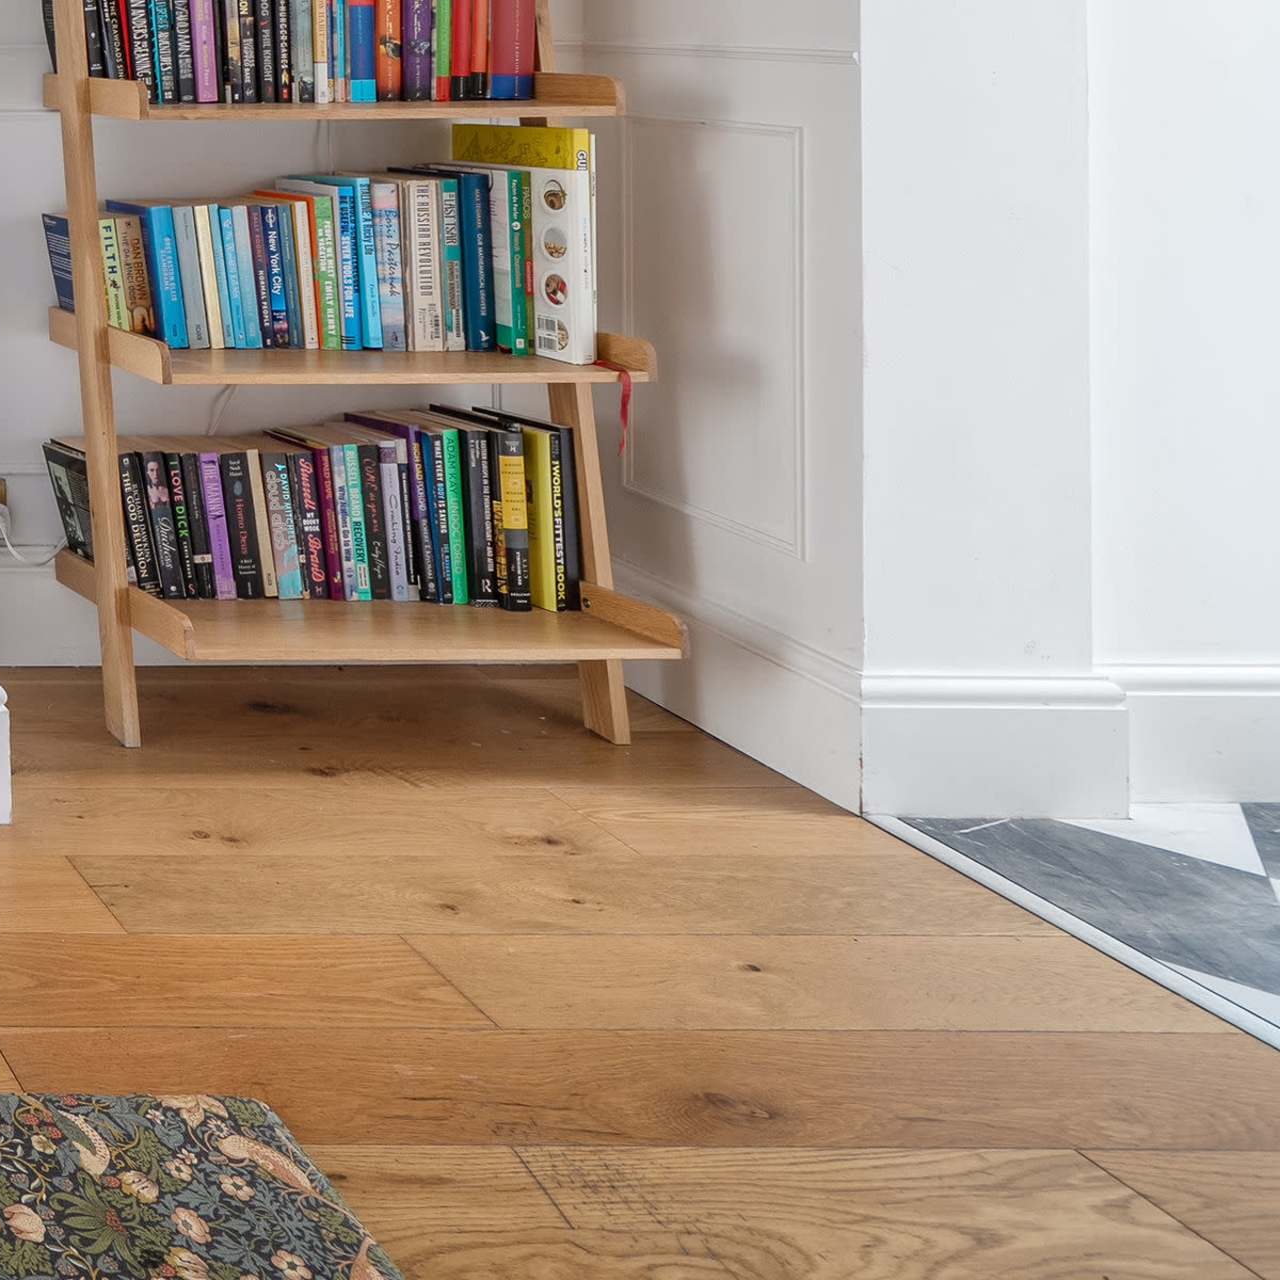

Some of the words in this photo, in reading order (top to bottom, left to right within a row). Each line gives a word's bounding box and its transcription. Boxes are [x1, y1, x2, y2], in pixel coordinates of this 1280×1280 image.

[131, 9, 148, 39] ANDERS
[111, 19, 121, 63] CRAWDADS
[262, 29, 270, 47] PHIL
[263, 50, 272, 82] KNIGHT
[416, 185, 429, 198] THE
[522, 186, 531, 219] PASOS
[417, 201, 431, 239] RUSSIAN
[444, 199, 457, 219] LAST
[323, 221, 332, 245] PEOPLE
[362, 224, 373, 243] Rocky
[384, 210, 398, 238] Boris
[445, 223, 458, 245] TSAR
[102, 225, 117, 274] FILTH
[131, 238, 141, 259] DAN
[267, 231, 277, 252] New
[364, 244, 374, 255] Life
[270, 254, 280, 274] York
[327, 258, 335, 277] MEET
[387, 242, 401, 297] Pasternak
[419, 242, 433, 297] REVOLUTION
[134, 262, 147, 301] BROWN
[258, 270, 267, 299] NORMAL
[271, 276, 282, 295] City
[324, 281, 334, 305] EMILY
[262, 302, 270, 327] PEOPLE
[479, 290, 487, 316] UNIVERSE
[327, 308, 336, 335] HENRY
[412, 442, 421, 463] RICH
[434, 440, 442, 459] WHAT
[446, 438, 456, 469] ADAM
[203, 465, 217, 479] THE
[347, 450, 357, 485] RUSSELL
[414, 464, 424, 480] DAD
[435, 460, 443, 480] EVERY
[172, 470, 183, 502] LOVE
[266, 471, 280, 511] cloud
[280, 474, 289, 500] DAVID
[299, 458, 316, 510] Russell
[338, 486, 346, 502] Why
[448, 472, 457, 495] KAY
[552, 466, 563, 518] WORLD'S
[205, 482, 222, 516] MANNY
[349, 488, 360, 516] BRAND
[437, 500, 444, 508] IS
[122, 471, 130, 493] THE
[126, 496, 137, 520] GOD
[132, 524, 148, 578] DELUSION
[132, 483, 144, 522] RICHARD
[140, 523, 151, 562] DAWKINS
[176, 506, 189, 537] DICK
[235, 499, 244, 528] Homo
[284, 502, 295, 545] MITCHELL
[340, 502, 350, 528] Nations
[389, 494, 400, 544] Cracking
[438, 510, 447, 534] SAYING
[159, 517, 174, 569] Duchess
[239, 531, 247, 555] Deus
[342, 530, 351, 539] Go
[353, 521, 366, 564] RECOVERY
[450, 497, 463, 574] UNDOCTORED
[554, 517, 565, 565] FITTEST
[308, 534, 325, 582] Brand
[345, 548, 354, 561] War
[393, 549, 401, 576] India
[557, 565, 566, 600] BOOK
